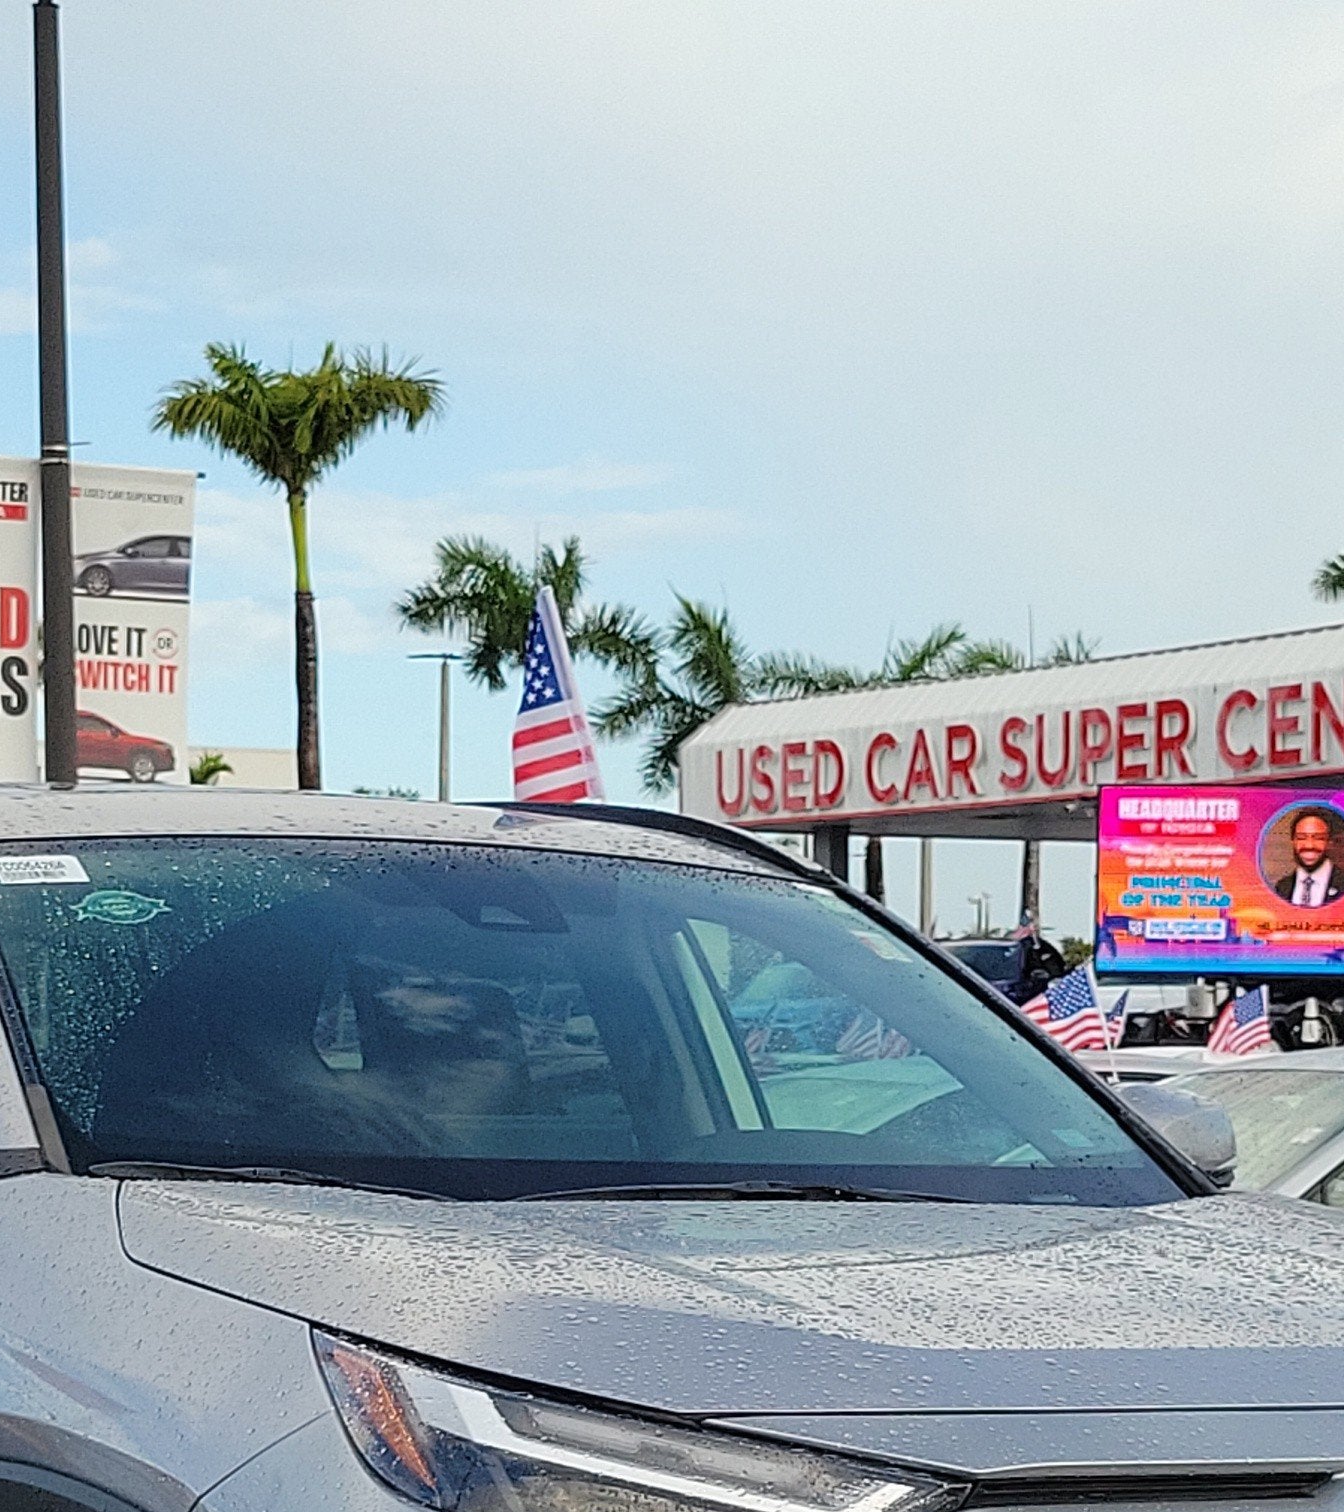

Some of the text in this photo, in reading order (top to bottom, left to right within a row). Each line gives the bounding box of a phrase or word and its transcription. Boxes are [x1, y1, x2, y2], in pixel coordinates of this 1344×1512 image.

[78, 623, 119, 656] OVE
[125, 626, 148, 658] IT
[76, 659, 179, 694] WITCH IT
[716, 738, 846, 817] USED
[864, 723, 981, 805] CAR
[998, 699, 1198, 792] SUPER
